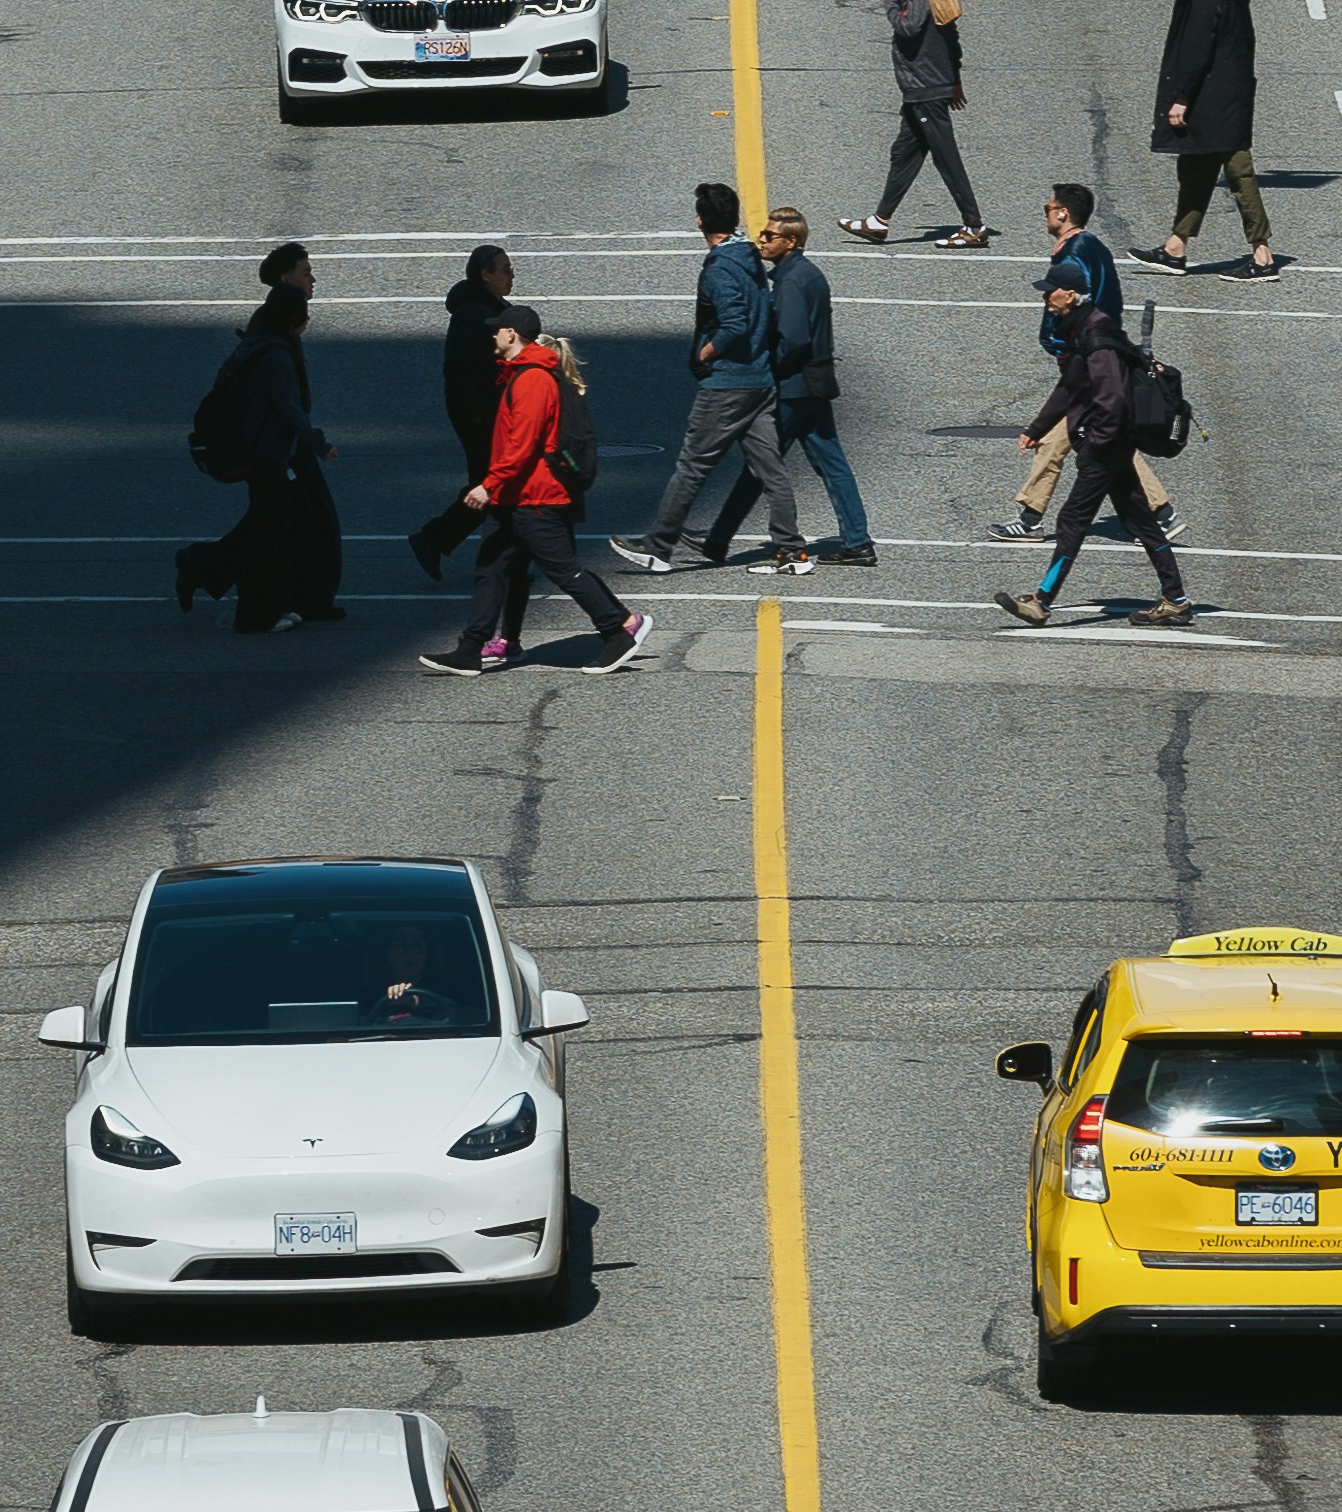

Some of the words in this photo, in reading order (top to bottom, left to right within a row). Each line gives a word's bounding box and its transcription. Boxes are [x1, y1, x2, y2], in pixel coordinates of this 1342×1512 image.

[1212, 936, 1282, 953] Yellow
[1290, 936, 1329, 952] Cab
[1128, 1146, 1235, 1164] 604-681-1111
